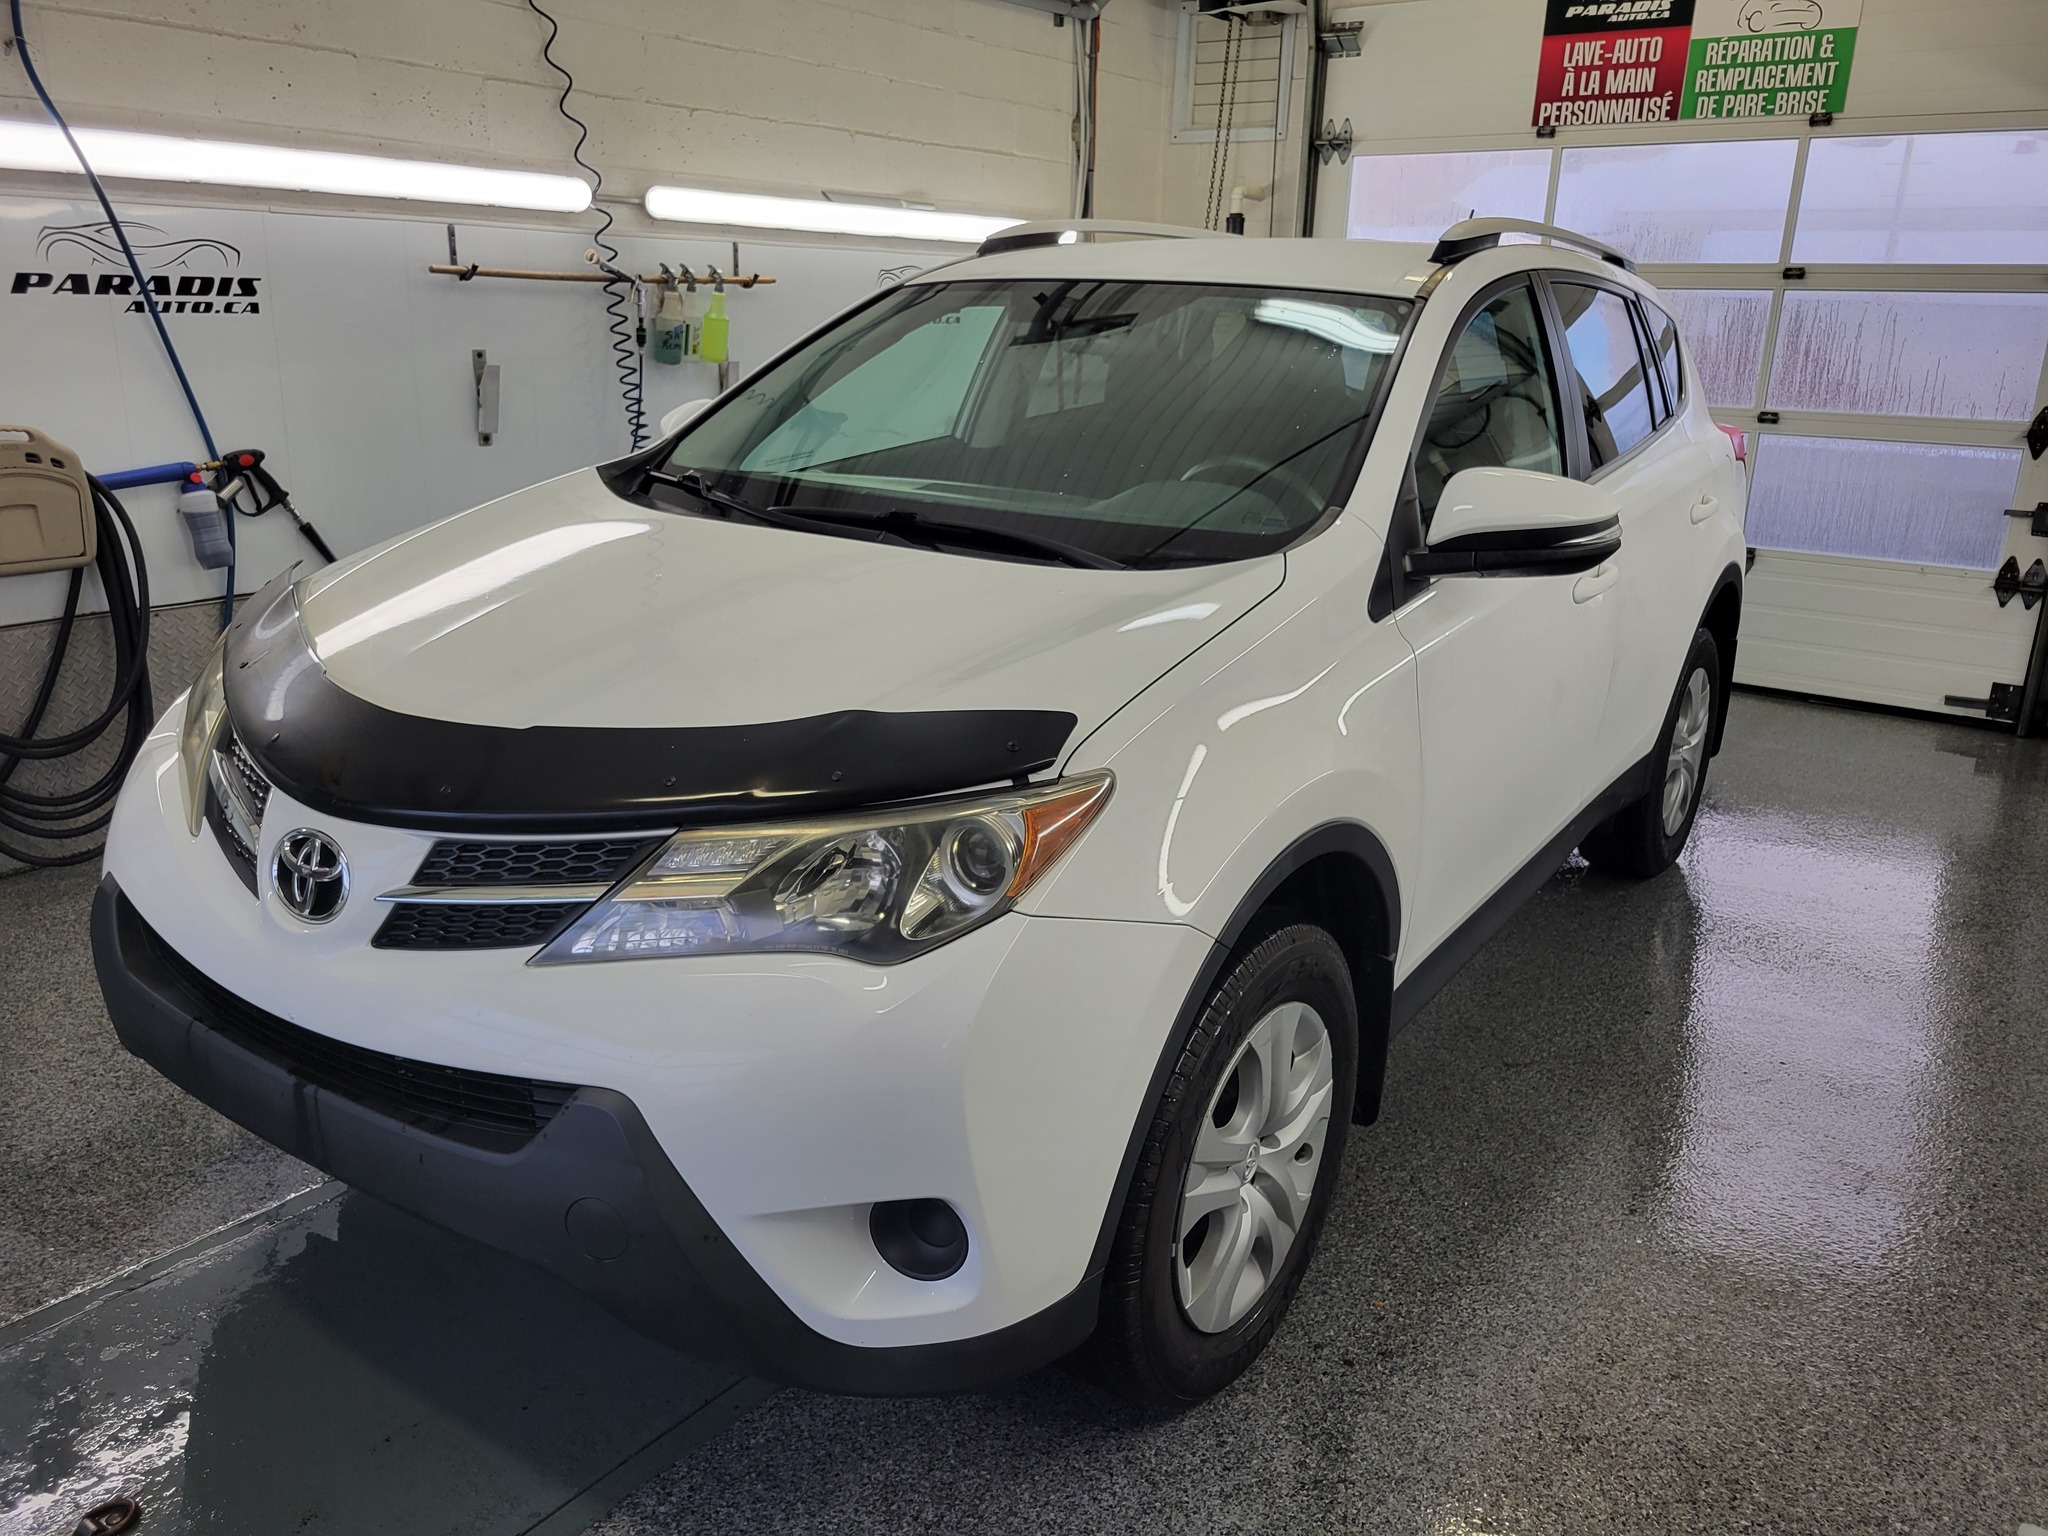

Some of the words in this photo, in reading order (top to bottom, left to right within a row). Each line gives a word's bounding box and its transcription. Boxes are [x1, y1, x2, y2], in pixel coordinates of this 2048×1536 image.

[1565, 0, 1675, 18] PARADIS
[1607, 10, 1671, 23] AUTO.CA
[1563, 36, 1664, 67] LAVE-AUTO
[1705, 34, 1816, 66] RÉPARATION
[1819, 34, 1835, 58] &
[1561, 67, 1575, 97] À
[1579, 70, 1601, 96] LA
[1605, 67, 1656, 95] MAIN
[1695, 61, 1840, 93] REMPLACEMENT
[1538, 90, 1673, 127] PERSONNALISÉ
[1695, 95, 1719, 119] DE
[1721, 90, 1830, 118] PARE-BRISE
[11, 272, 262, 297] PARADIS
[124, 300, 260, 314] AUTO.CA
